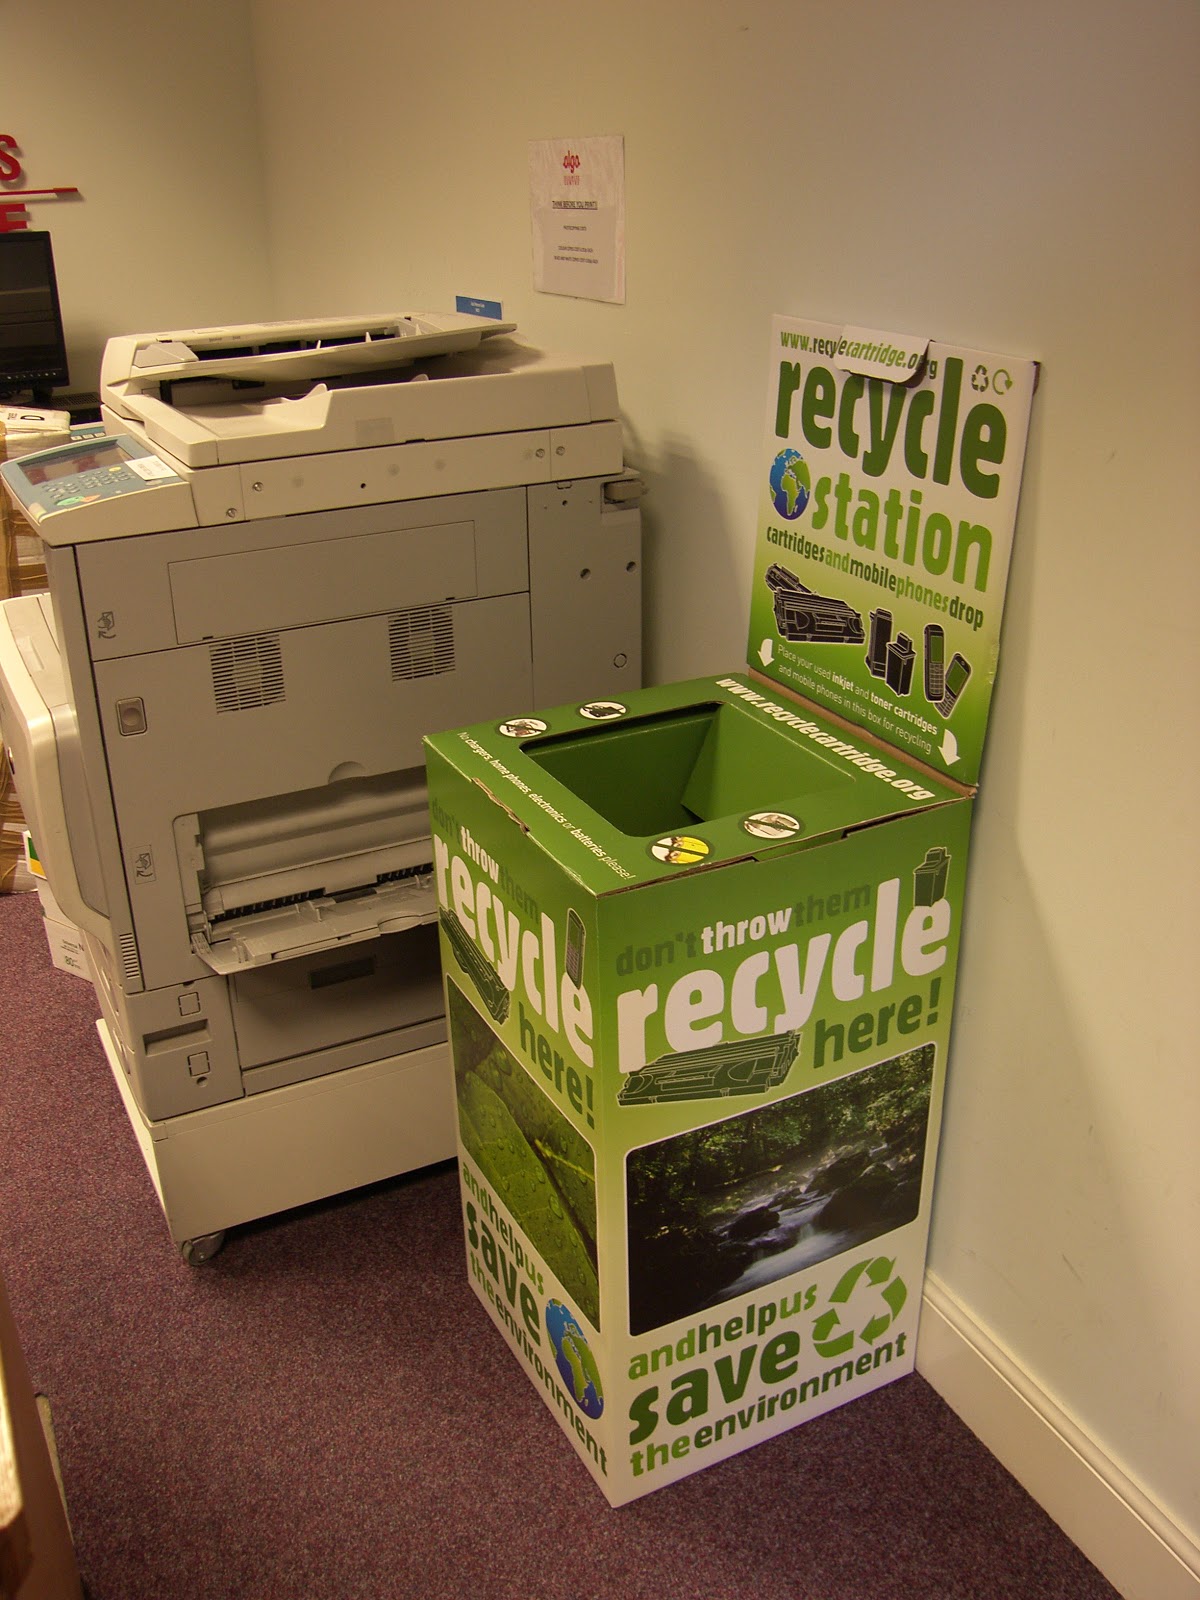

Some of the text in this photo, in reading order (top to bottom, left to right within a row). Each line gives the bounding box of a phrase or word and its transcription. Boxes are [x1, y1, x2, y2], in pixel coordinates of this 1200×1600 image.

[775, 357, 1007, 500] recycle
[811, 472, 993, 593] station
[715, 677, 936, 801] www.recyclecartridge.org
[778, 644, 938, 735] Place your used inkjet and toner cartridges
[778, 665, 932, 755] and mobile phones in this box for recycling
[457, 732, 637, 880] No chargers, home phones, electronics or batteries please!
[433, 834, 594, 1069] recycle
[617, 877, 951, 1074] recycle
[517, 1000, 594, 1129] here!
[813, 976, 942, 1070] here!
[466, 1200, 541, 1347] save
[629, 1330, 801, 1446] save
